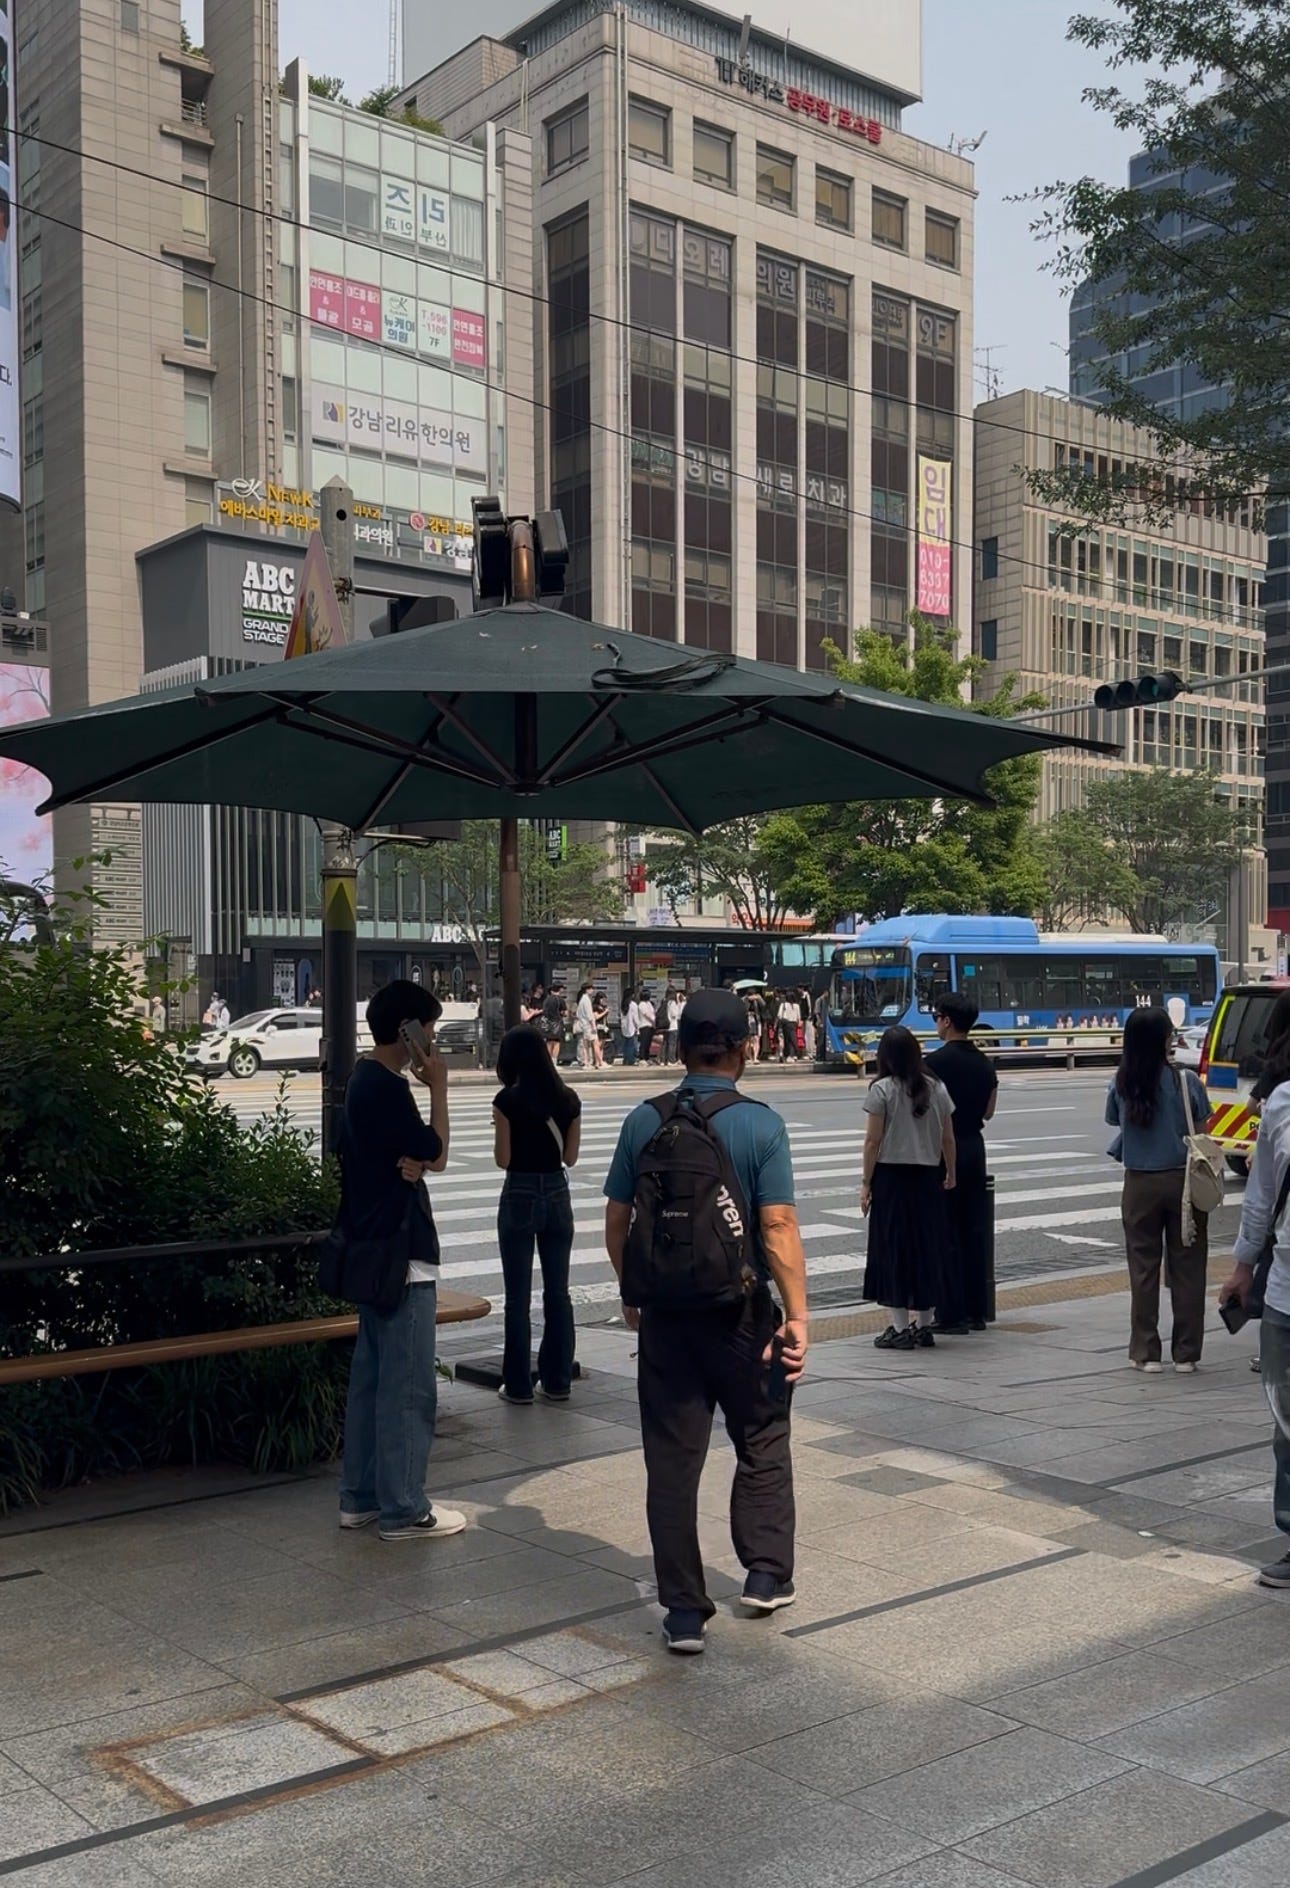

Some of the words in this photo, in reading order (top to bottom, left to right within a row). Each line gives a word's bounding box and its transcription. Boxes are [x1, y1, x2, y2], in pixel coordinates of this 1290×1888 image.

[739, 68, 785, 100] 해커스
[384, 314, 415, 333] 뉴케이
[387, 328, 409, 344] 의원
[429, 336, 441, 348] 7F
[348, 405, 471, 454] 강남리유한의원
[686, 449, 730, 485] 강남
[924, 465, 946, 544] 임대
[428, 516, 450, 536] 강남
[242, 560, 295, 595] ABC
[242, 589, 296, 615] MART
[919, 590, 949, 609] 7070
[243, 618, 289, 634] GRAND
[243, 630, 285, 645] STAGE
[1135, 994, 1152, 1008] 144
